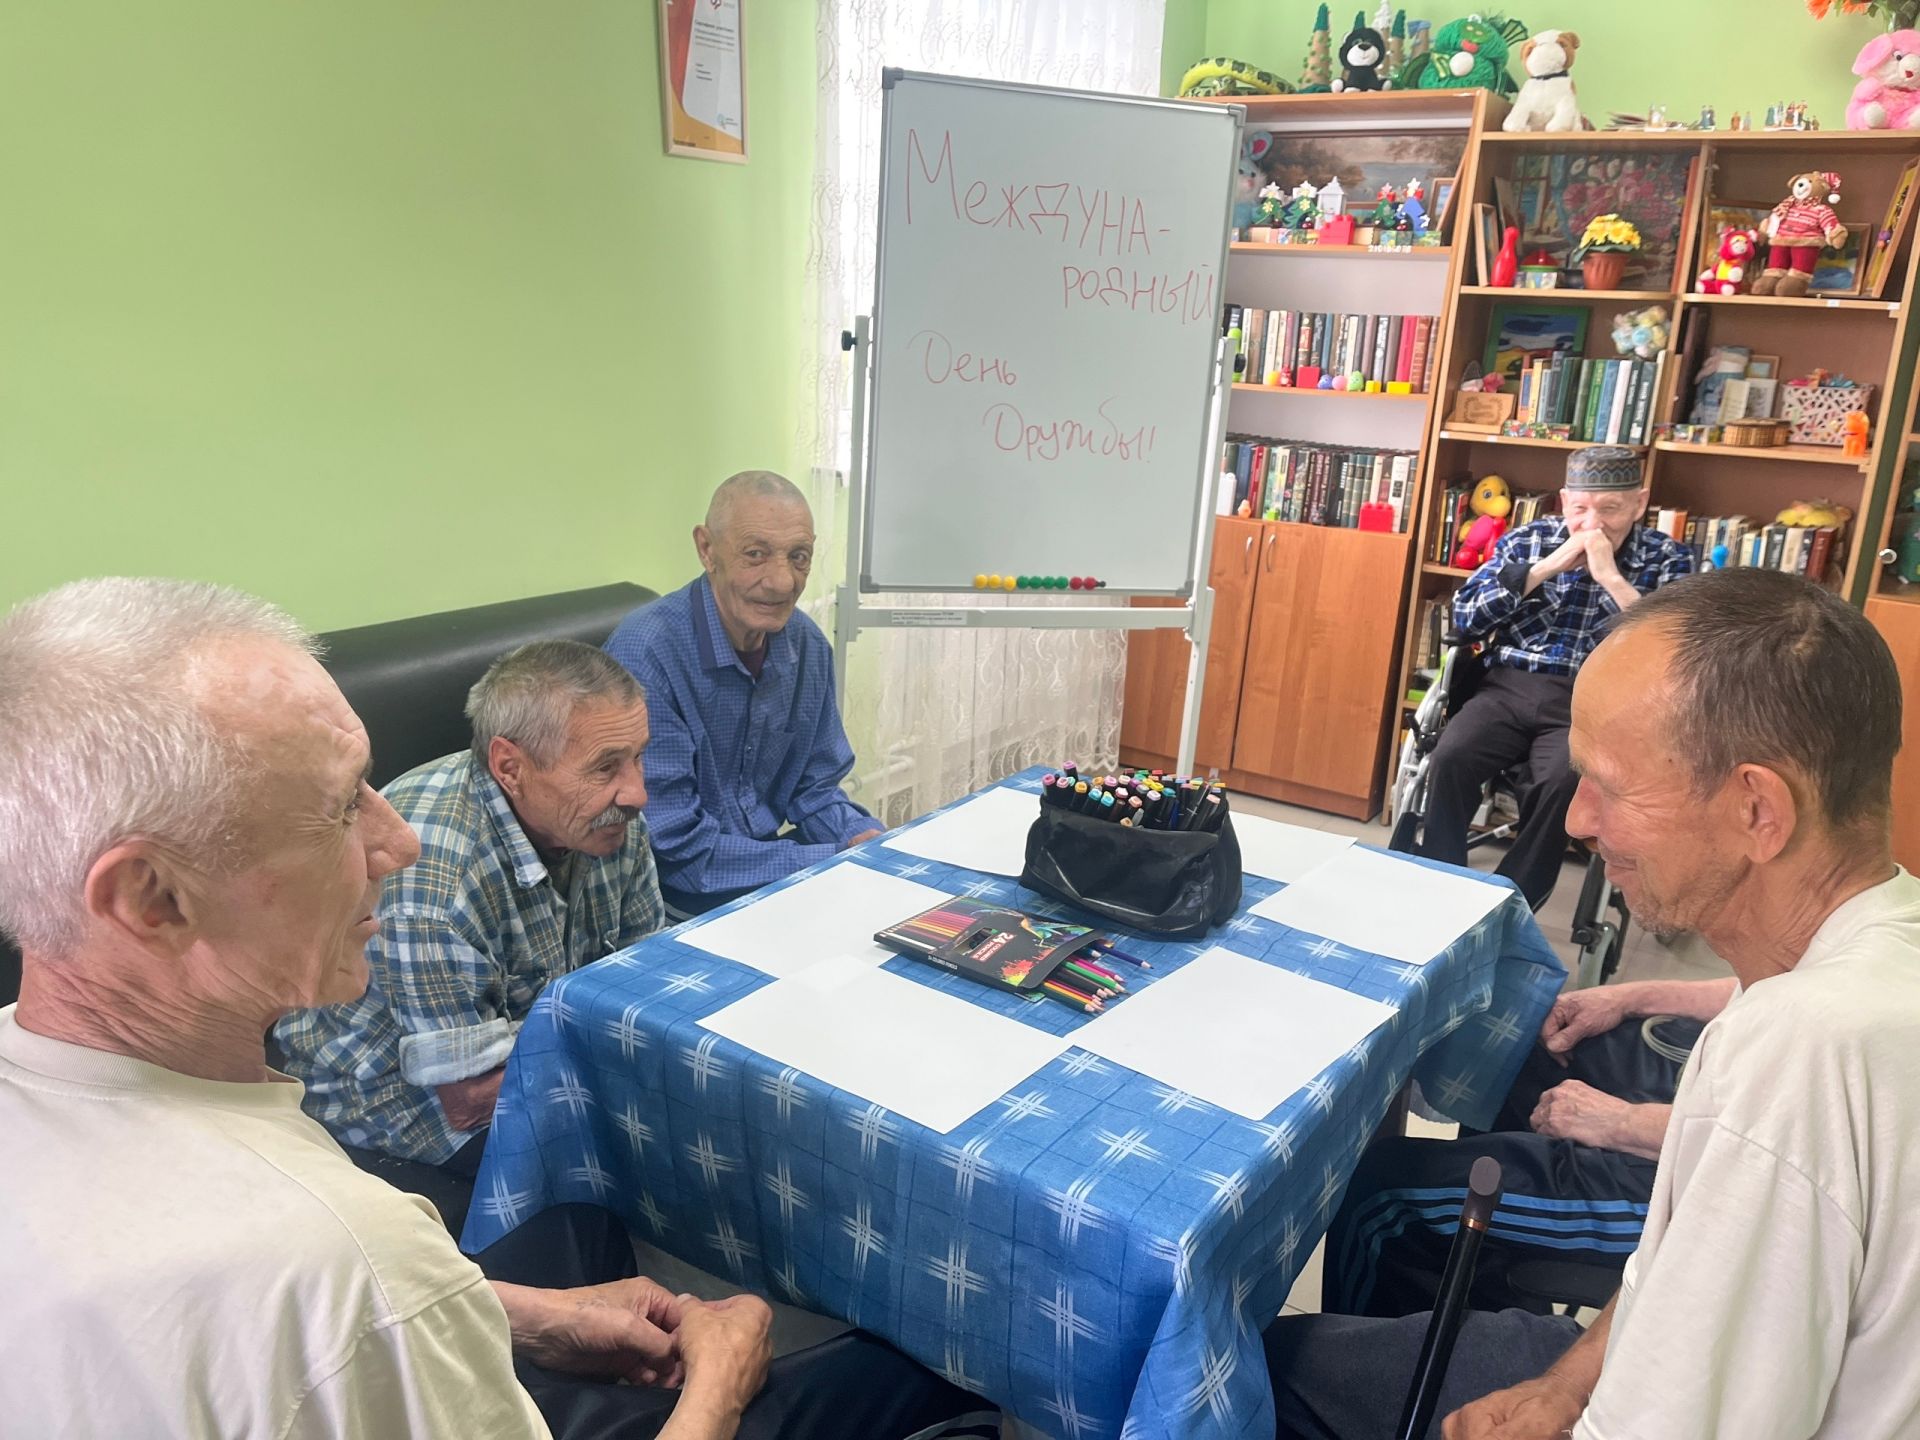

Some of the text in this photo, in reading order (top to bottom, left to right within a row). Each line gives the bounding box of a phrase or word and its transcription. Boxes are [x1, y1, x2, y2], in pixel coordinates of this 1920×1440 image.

[906, 329, 1018, 387] День
[982, 395, 1157, 464] Дружбы!
[992, 931, 1015, 945] 24
